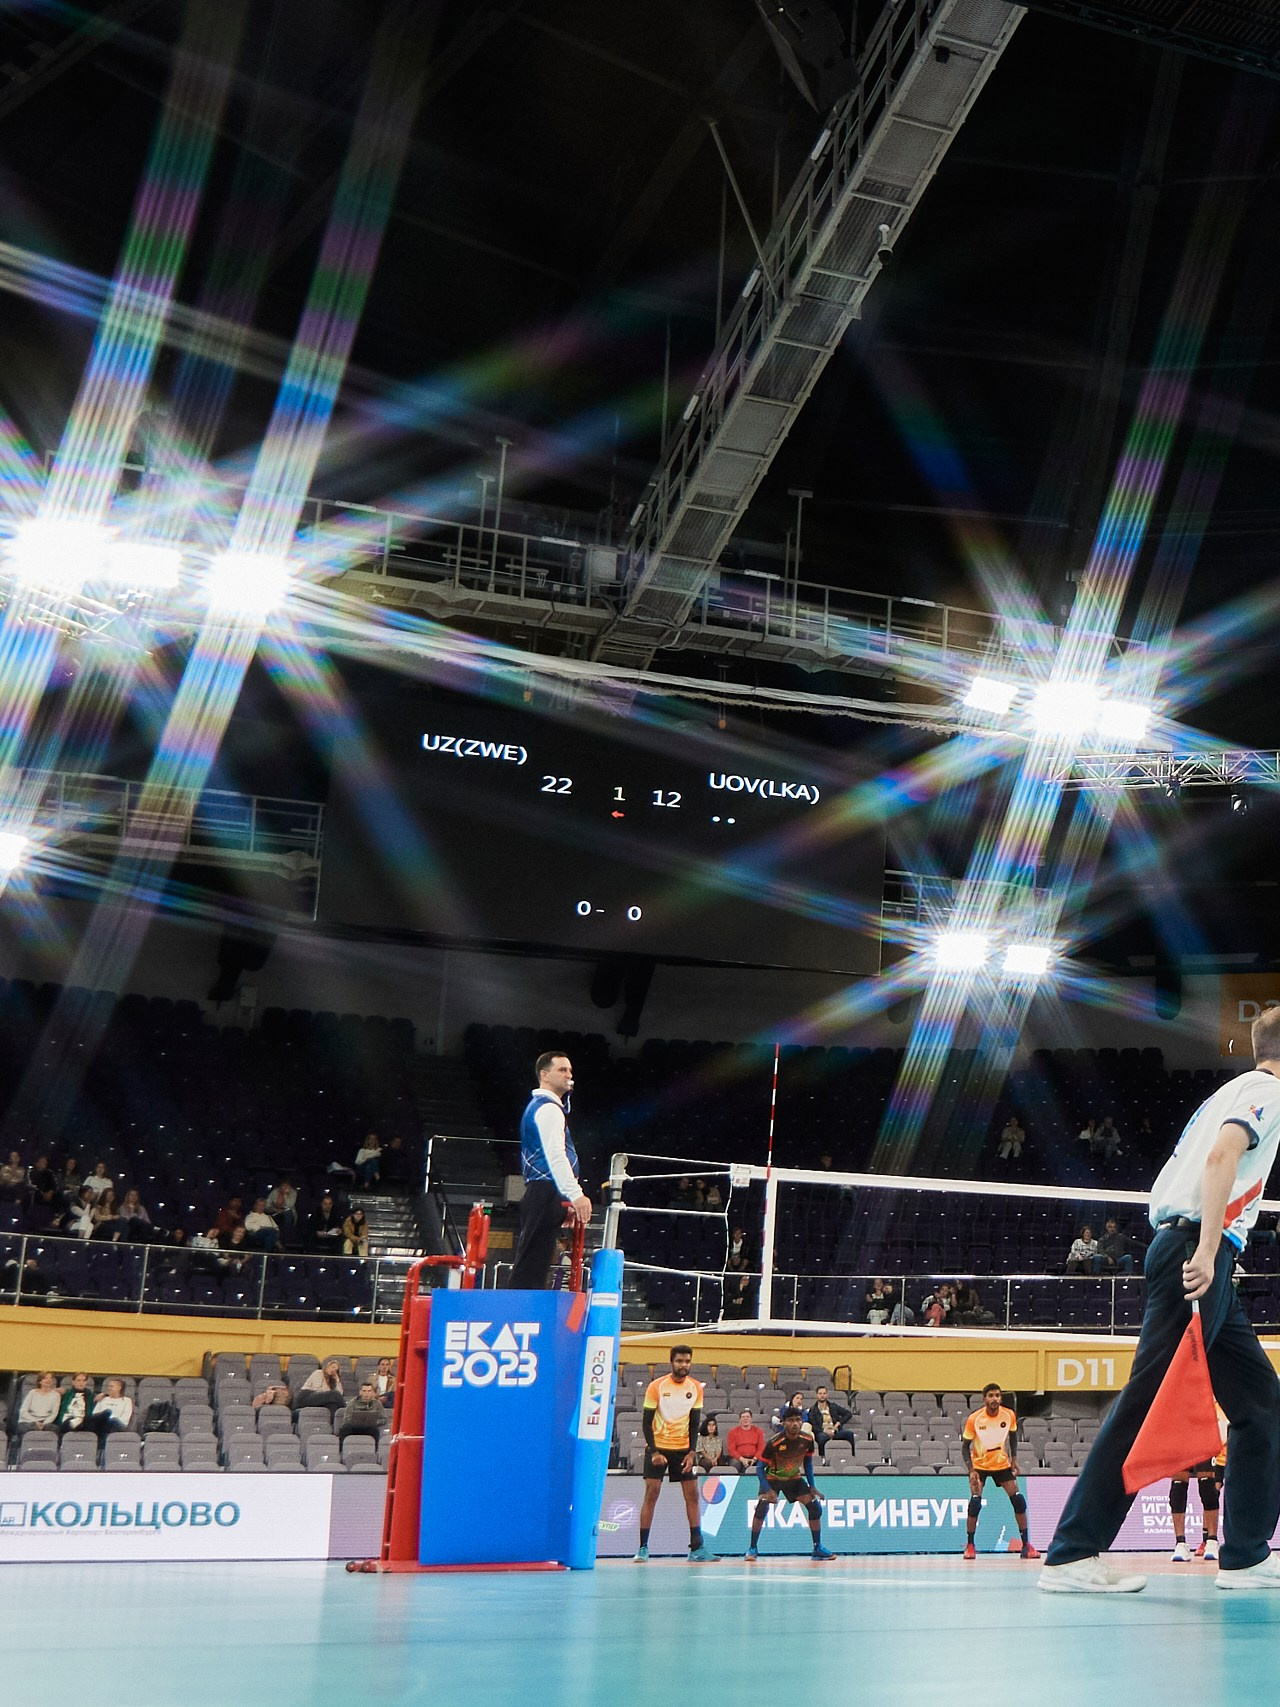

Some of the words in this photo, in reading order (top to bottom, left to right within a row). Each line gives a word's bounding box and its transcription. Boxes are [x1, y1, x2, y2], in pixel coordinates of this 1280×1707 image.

[421, 733, 528, 765] UZ(ZWE)
[541, 775, 573, 795] 22
[613, 786, 626, 801] 1
[652, 789, 682, 808] 12
[709, 772, 820, 804] UOV(LKA)
[628, 905, 642, 922] 0
[445, 1322, 540, 1350] EKAT
[443, 1351, 538, 1387] 2023
[1057, 1358, 1115, 1386] D11
[30, 1500, 241, 1530] КОЛЬЦОВО
[747, 1499, 987, 1528] ЕКАЕРИНБУР
